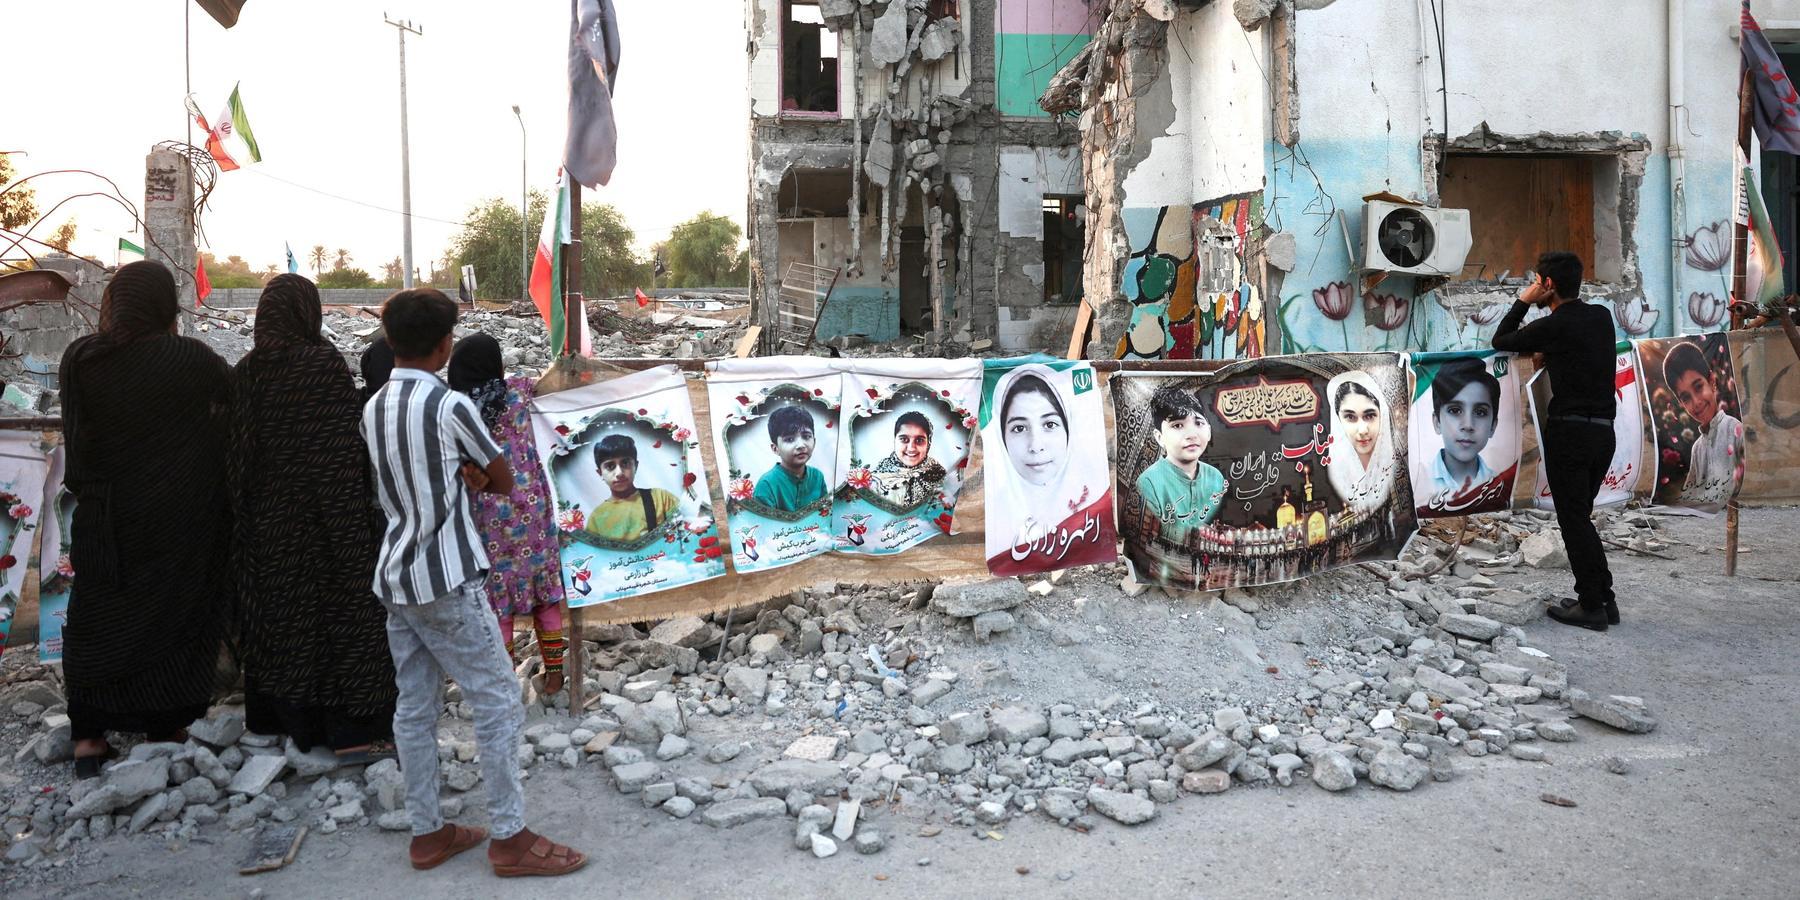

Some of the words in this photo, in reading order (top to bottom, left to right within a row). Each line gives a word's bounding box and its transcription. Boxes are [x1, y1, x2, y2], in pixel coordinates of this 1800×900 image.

[1281, 423, 1334, 472] میناب
[1230, 450, 1266, 481] ایران
[645, 550, 666, 562] شهید
[642, 566, 655, 577] علی
